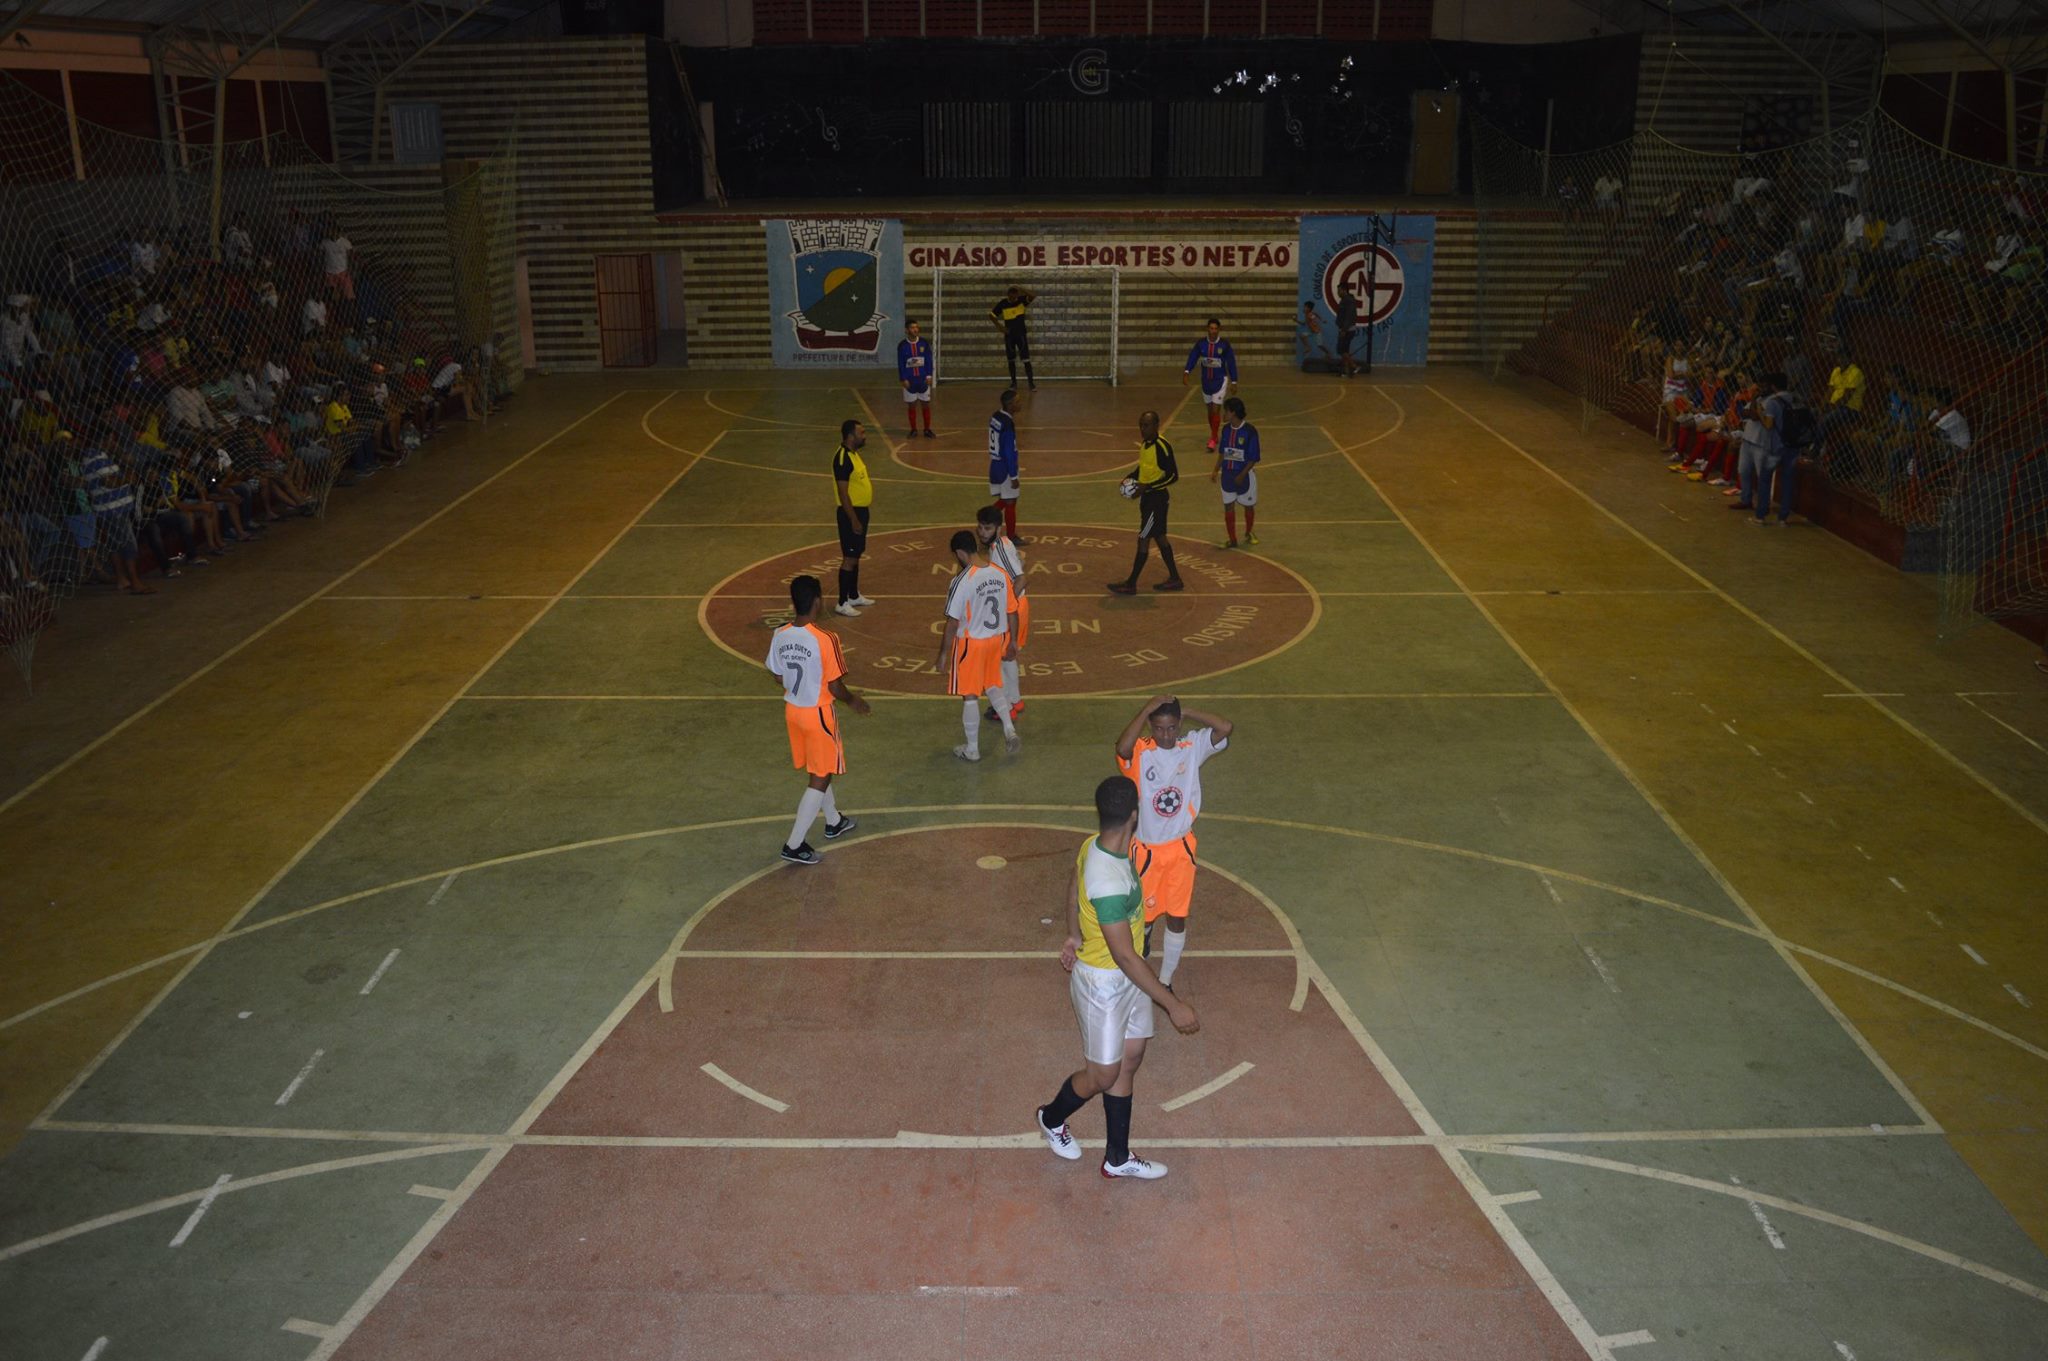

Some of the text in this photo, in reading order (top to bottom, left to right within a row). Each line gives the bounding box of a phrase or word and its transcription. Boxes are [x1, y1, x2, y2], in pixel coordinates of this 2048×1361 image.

[909, 243, 1007, 267] GINÁSIO
[1017, 246, 1046, 266] DE
[1058, 245, 1174, 266] ESPORTES
[845, 353, 857, 361] DE
[887, 540, 933, 553] DE
[1018, 535, 1118, 549] ORTES
[983, 596, 1000, 630] 3
[1111, 648, 1169, 667] DE
[786, 661, 803, 697] 7
